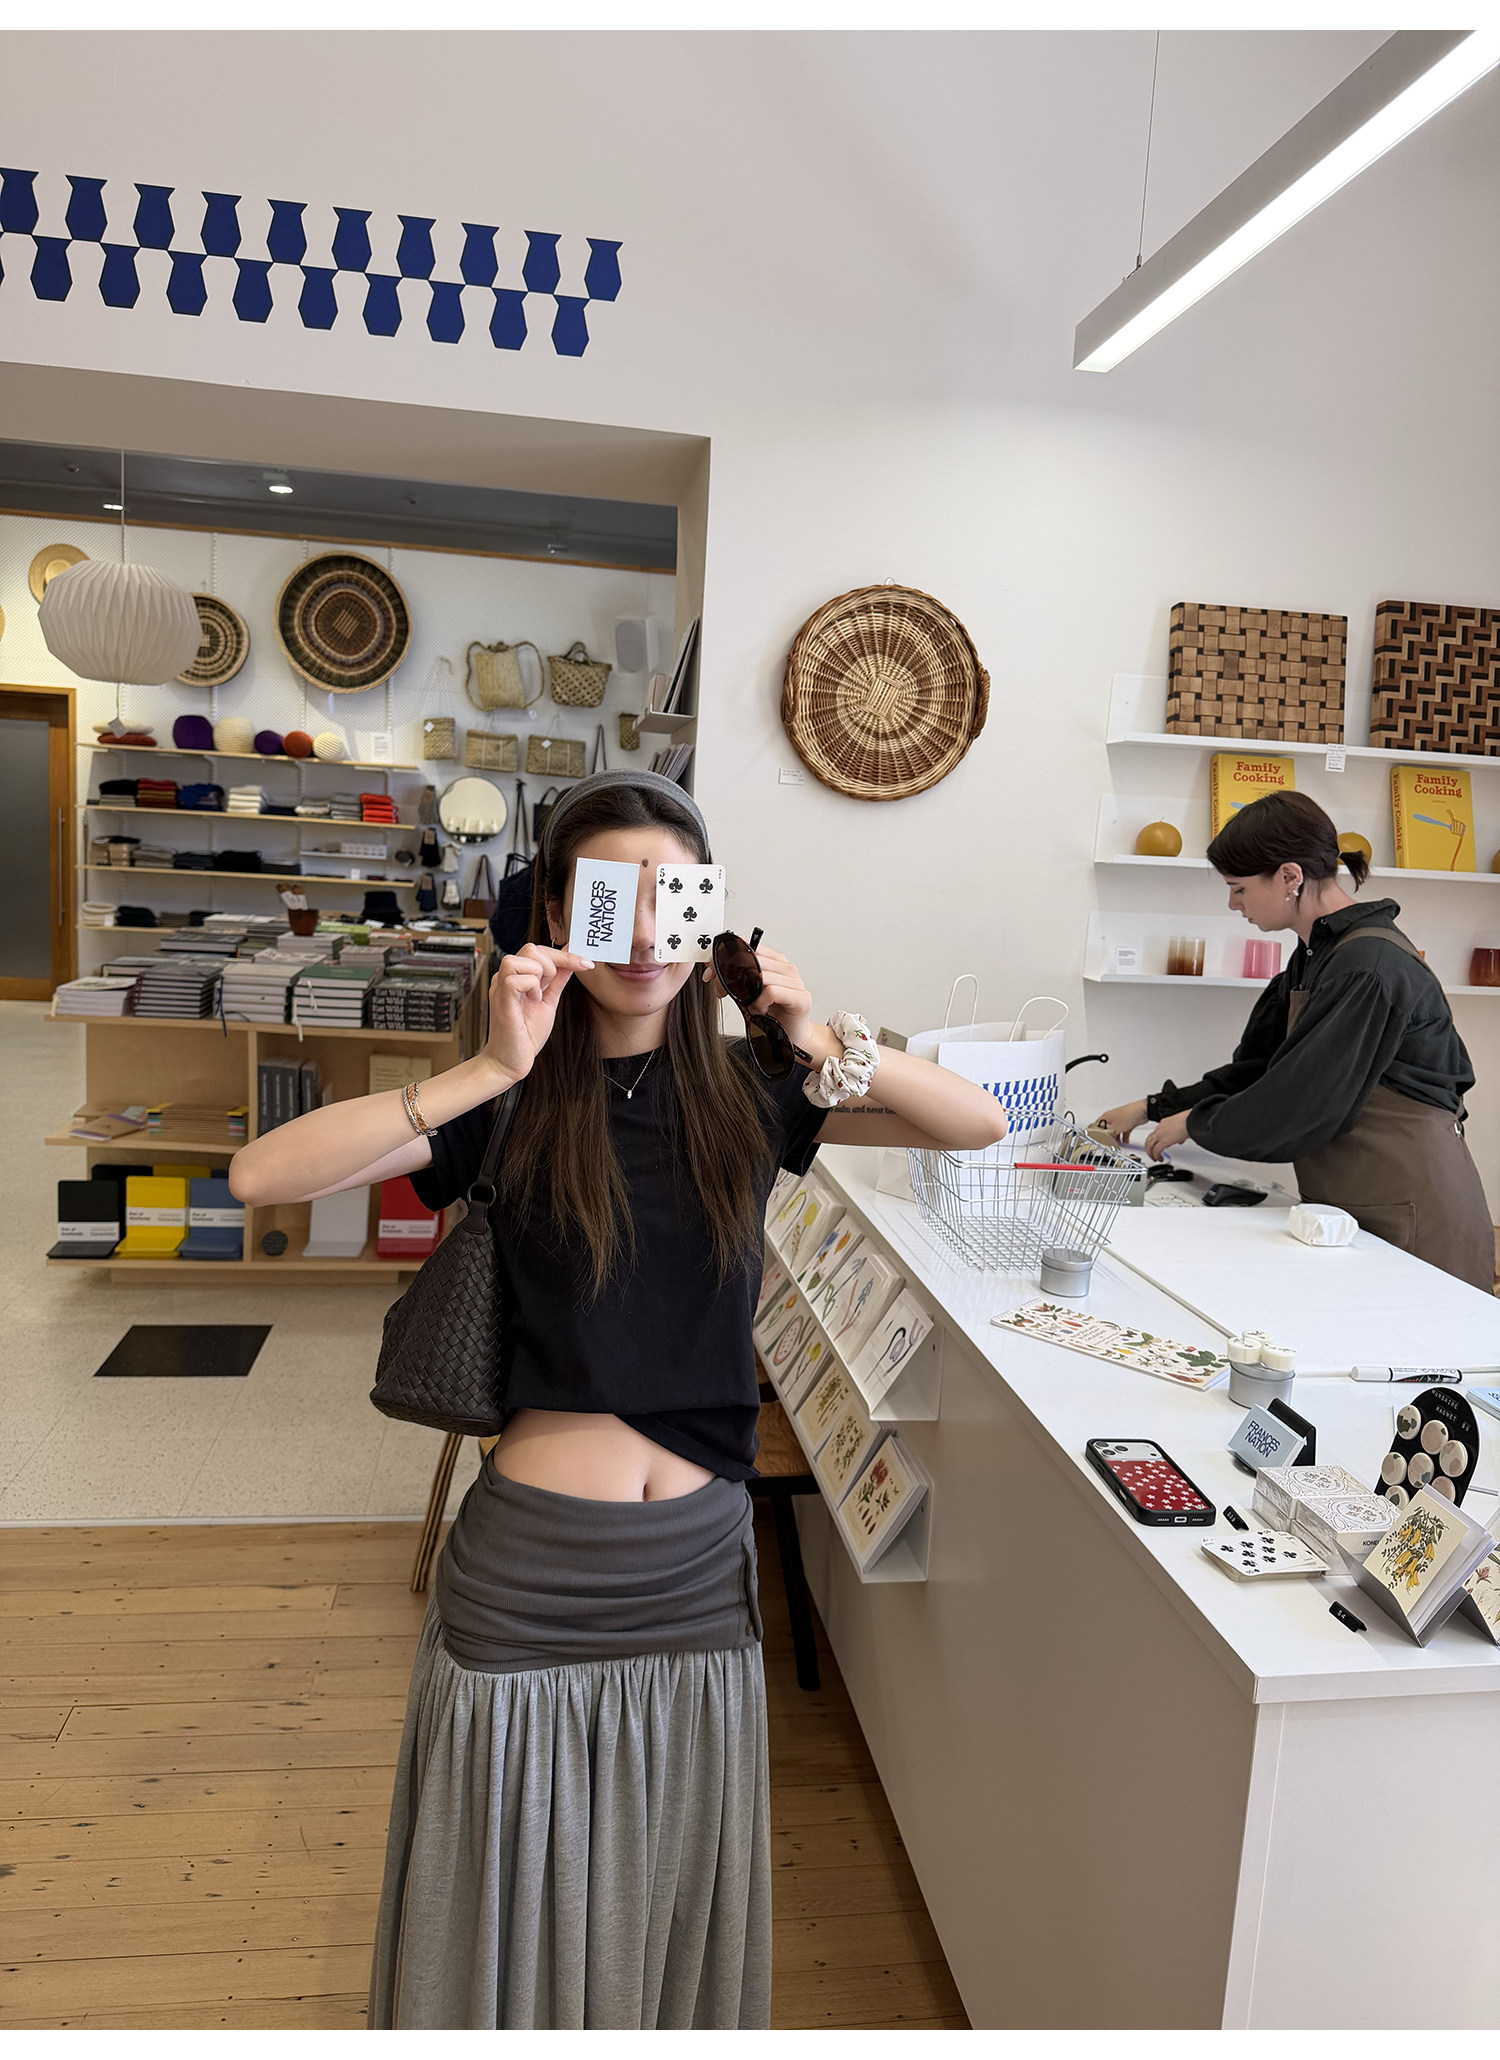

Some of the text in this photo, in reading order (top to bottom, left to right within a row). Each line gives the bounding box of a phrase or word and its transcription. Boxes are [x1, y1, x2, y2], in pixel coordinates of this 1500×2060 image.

[1236, 761, 1281, 774] Family
[1233, 772, 1285, 785] Cooking
[1416, 774, 1458, 787] Family
[1414, 784, 1462, 798] Cooking
[586, 880, 606, 947] FRANCES
[599, 889, 618, 942] NATION
[1435, 1405, 1458, 1422] MAGNET
[1244, 1431, 1272, 1458] NATION
[1247, 1420, 1281, 1452] FRANCES
